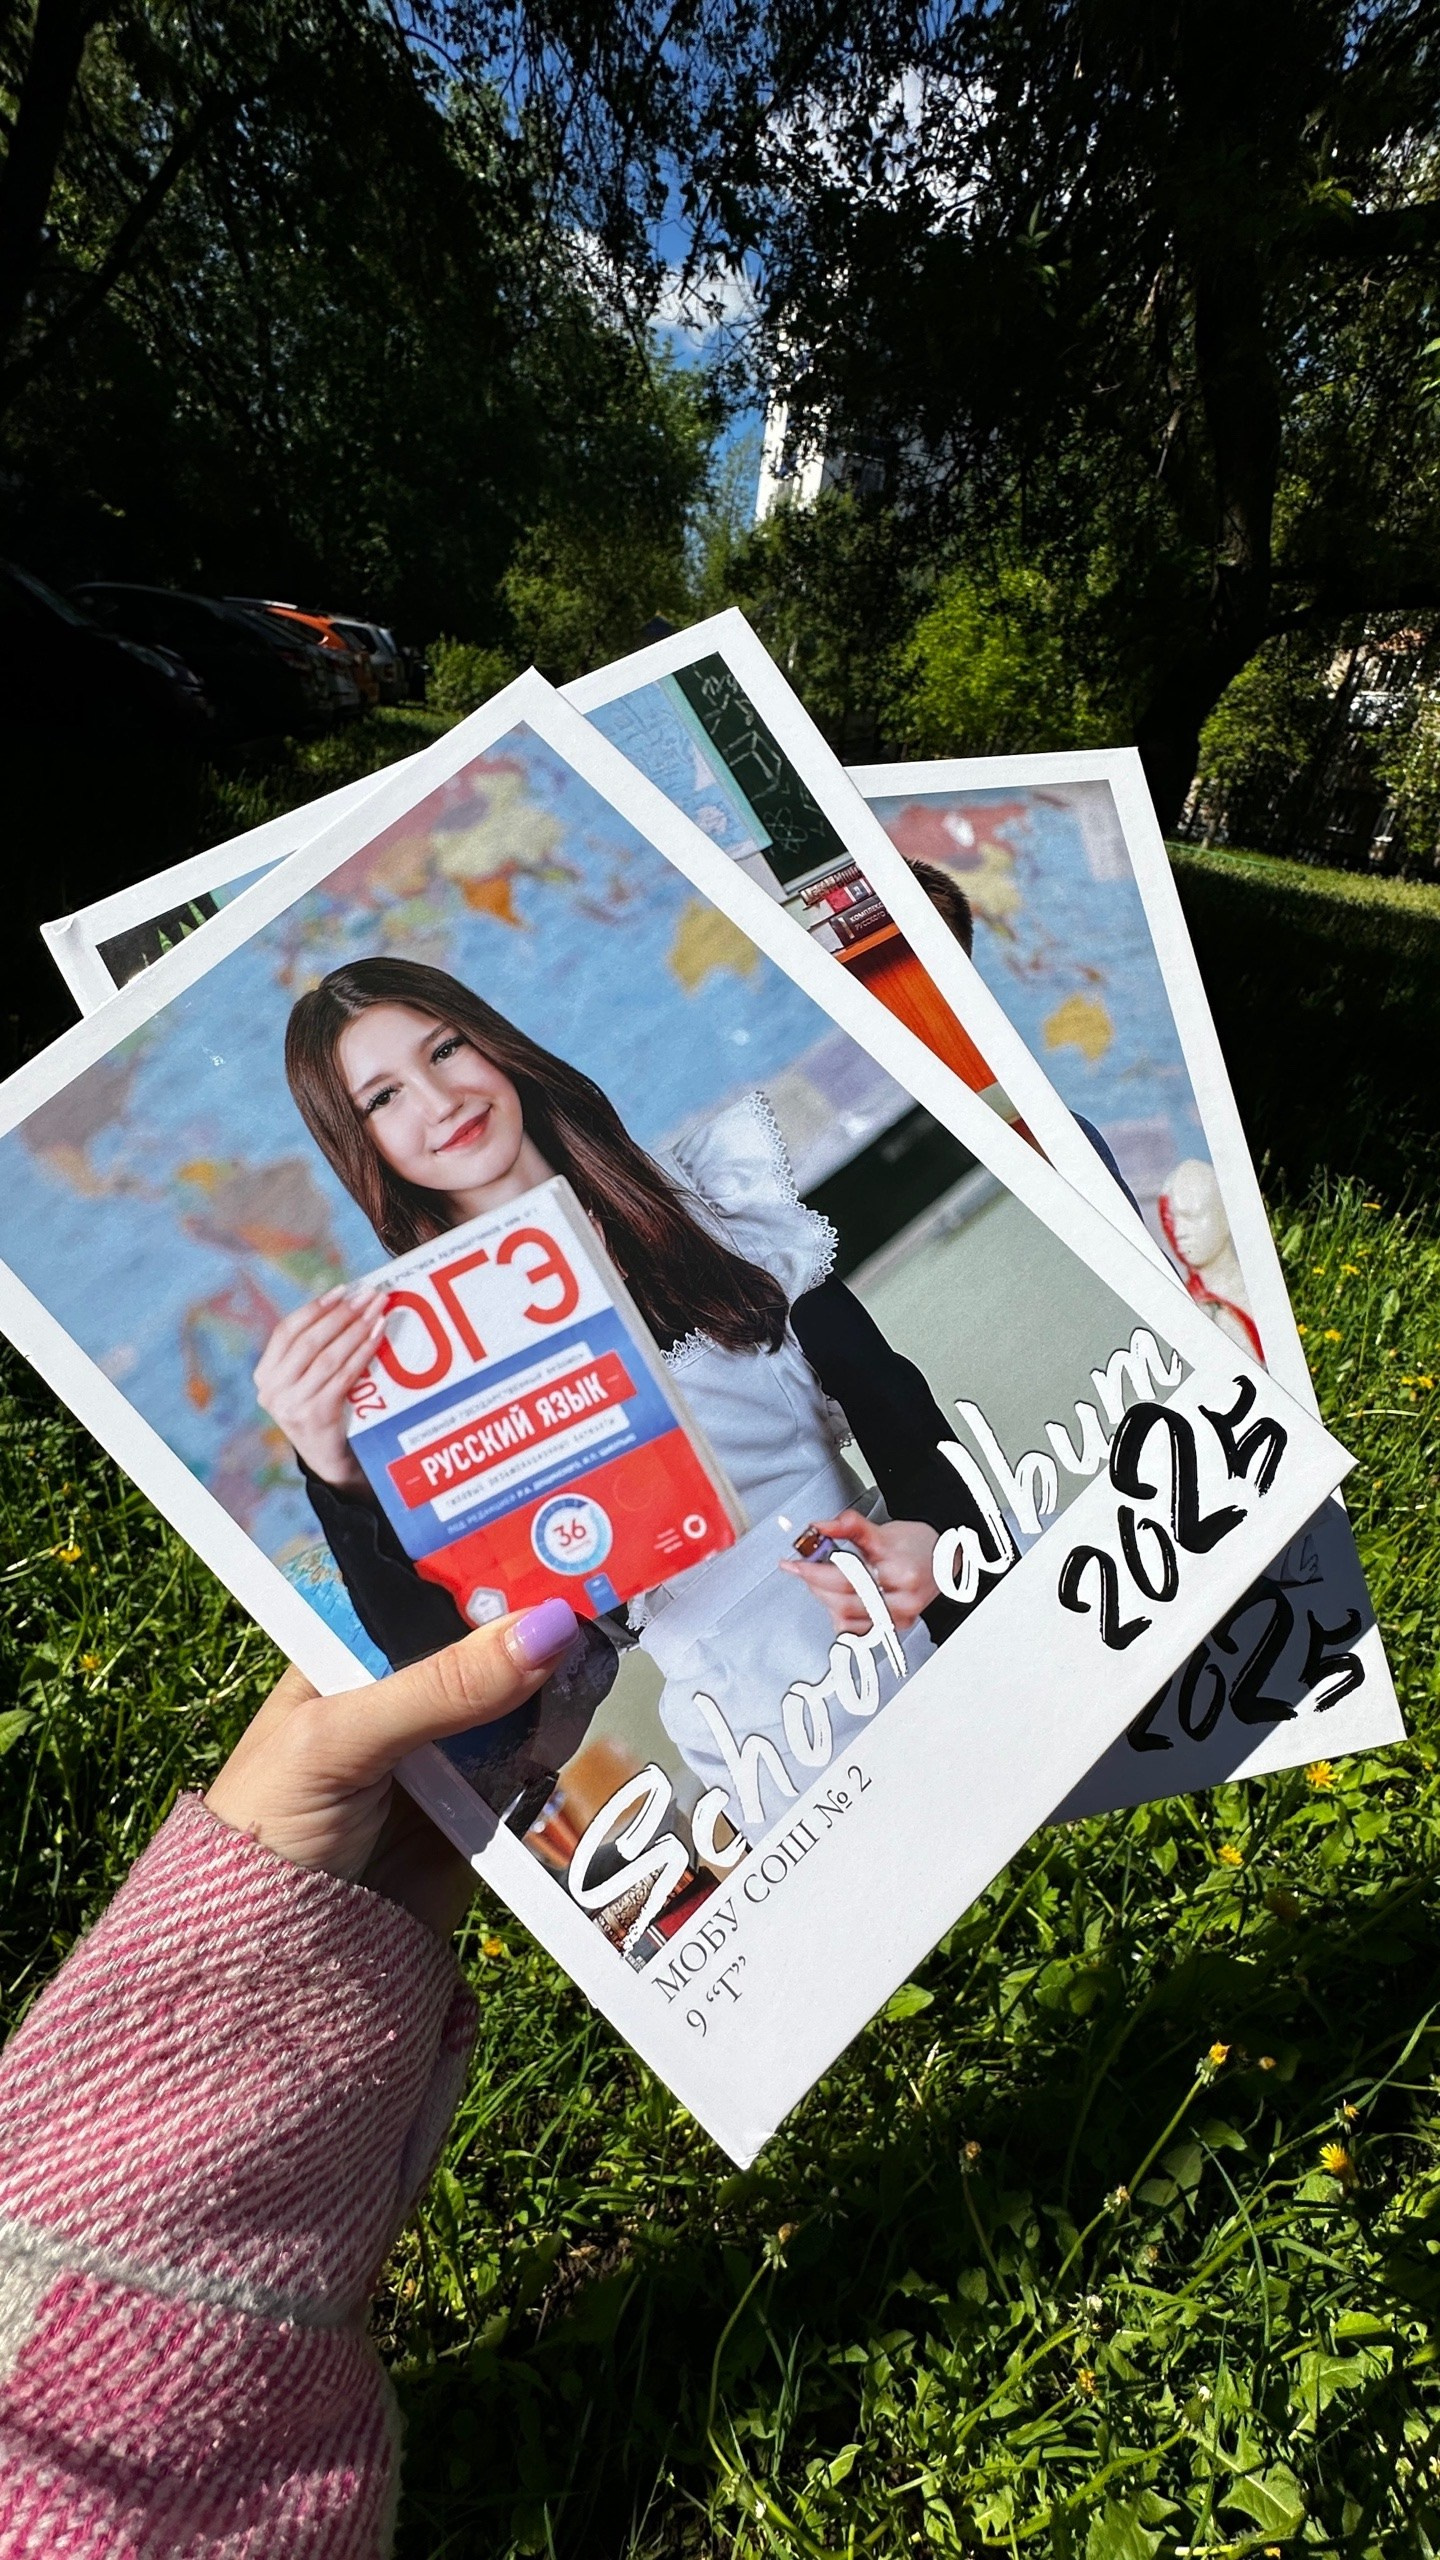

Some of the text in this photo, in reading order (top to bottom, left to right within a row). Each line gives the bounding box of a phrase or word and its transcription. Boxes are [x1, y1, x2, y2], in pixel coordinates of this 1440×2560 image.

[376, 1227, 580, 1390] ОГЭ
[348, 1367, 387, 1420] 20
[420, 1404, 536, 1486] РУССКИЙ
[535, 1371, 609, 1427] ЯЗЫК
[553, 1519, 587, 1547] 36
[1058, 1375, 1288, 1650] 2025
[568, 1328, 1183, 1959] School album
[651, 1765, 873, 2004] МОБУ СОШ № 2
[686, 2009, 708, 2037] 9
